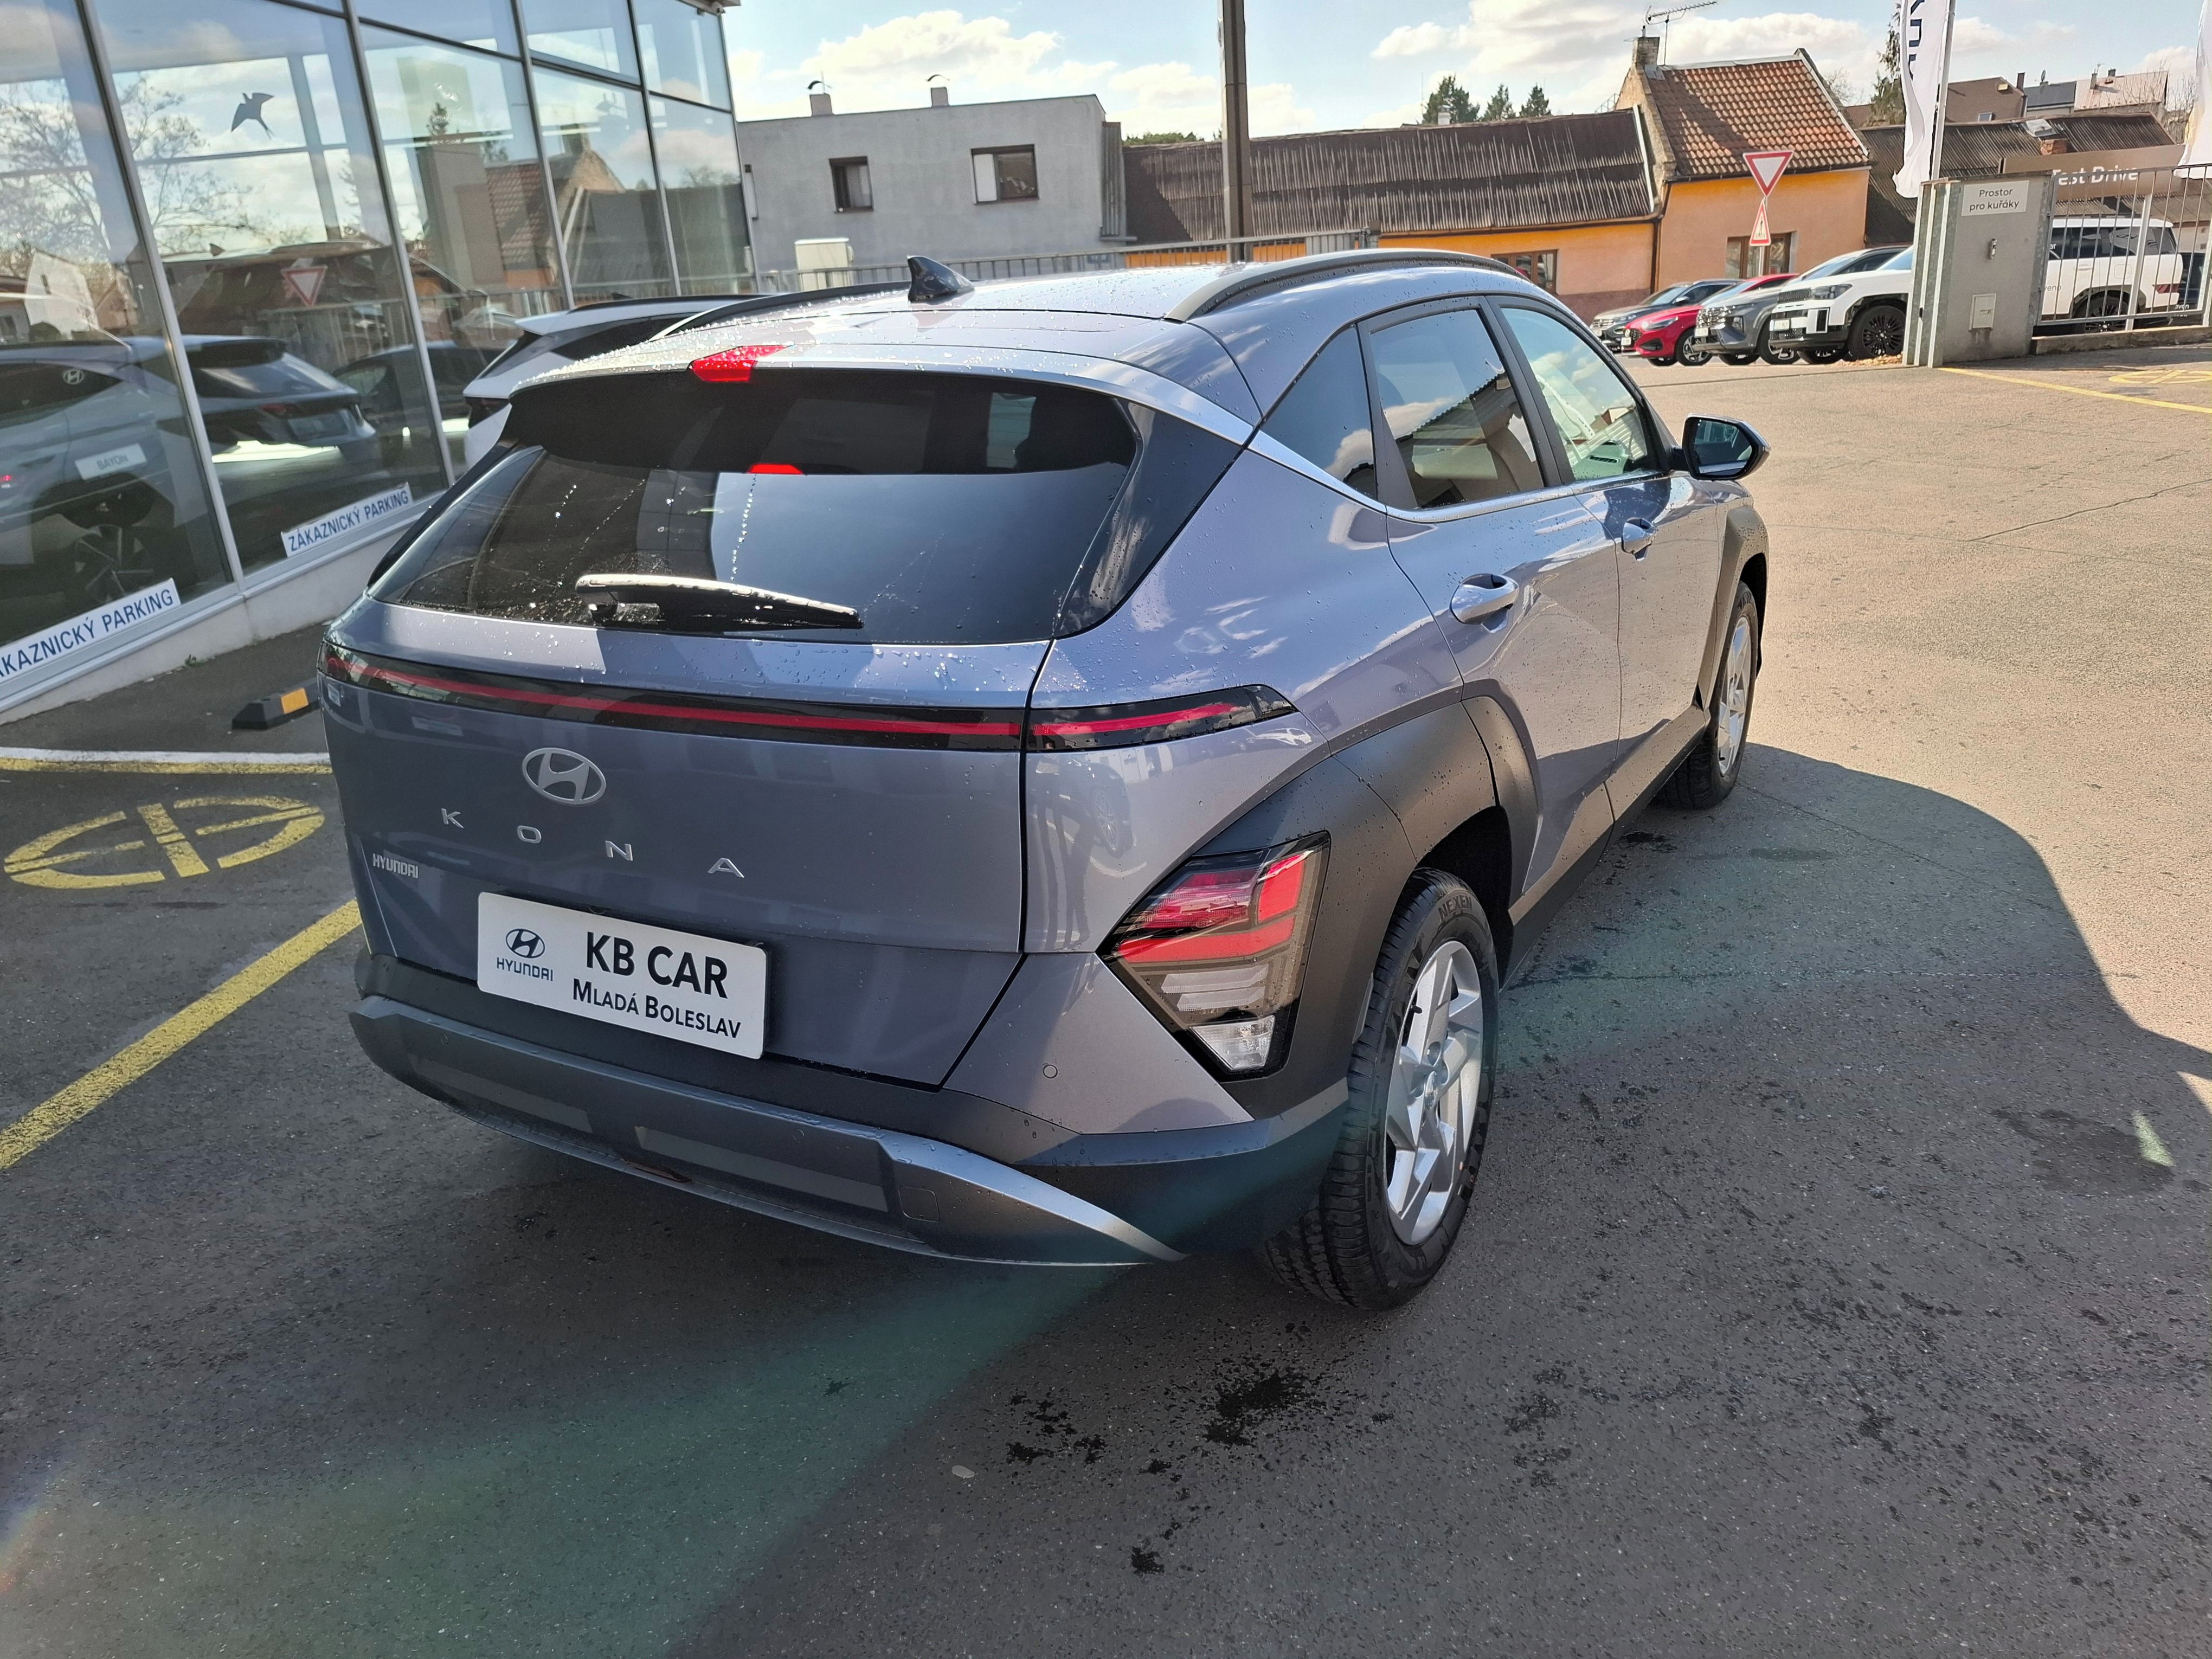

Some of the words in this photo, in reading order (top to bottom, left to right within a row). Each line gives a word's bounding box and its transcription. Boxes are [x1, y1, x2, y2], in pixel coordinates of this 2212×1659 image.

[1979, 188, 2013, 197] Prostor
[1969, 203, 1985, 213] pro
[1987, 200, 2020, 209] kuřáky
[288, 506, 360, 551] ZÁKAZNICKÝ
[364, 491, 409, 519] PARKING
[0, 617, 94, 678] KAZNICKÝ
[102, 589, 173, 632] PARKING
[441, 808, 745, 878] KONA
[372, 853, 419, 878] HYUNDAI
[1438, 895, 1472, 921] NEXEN
[497, 956, 554, 982] HYUNDAI
[586, 931, 635, 976] KB
[647, 945, 729, 999] CAR
